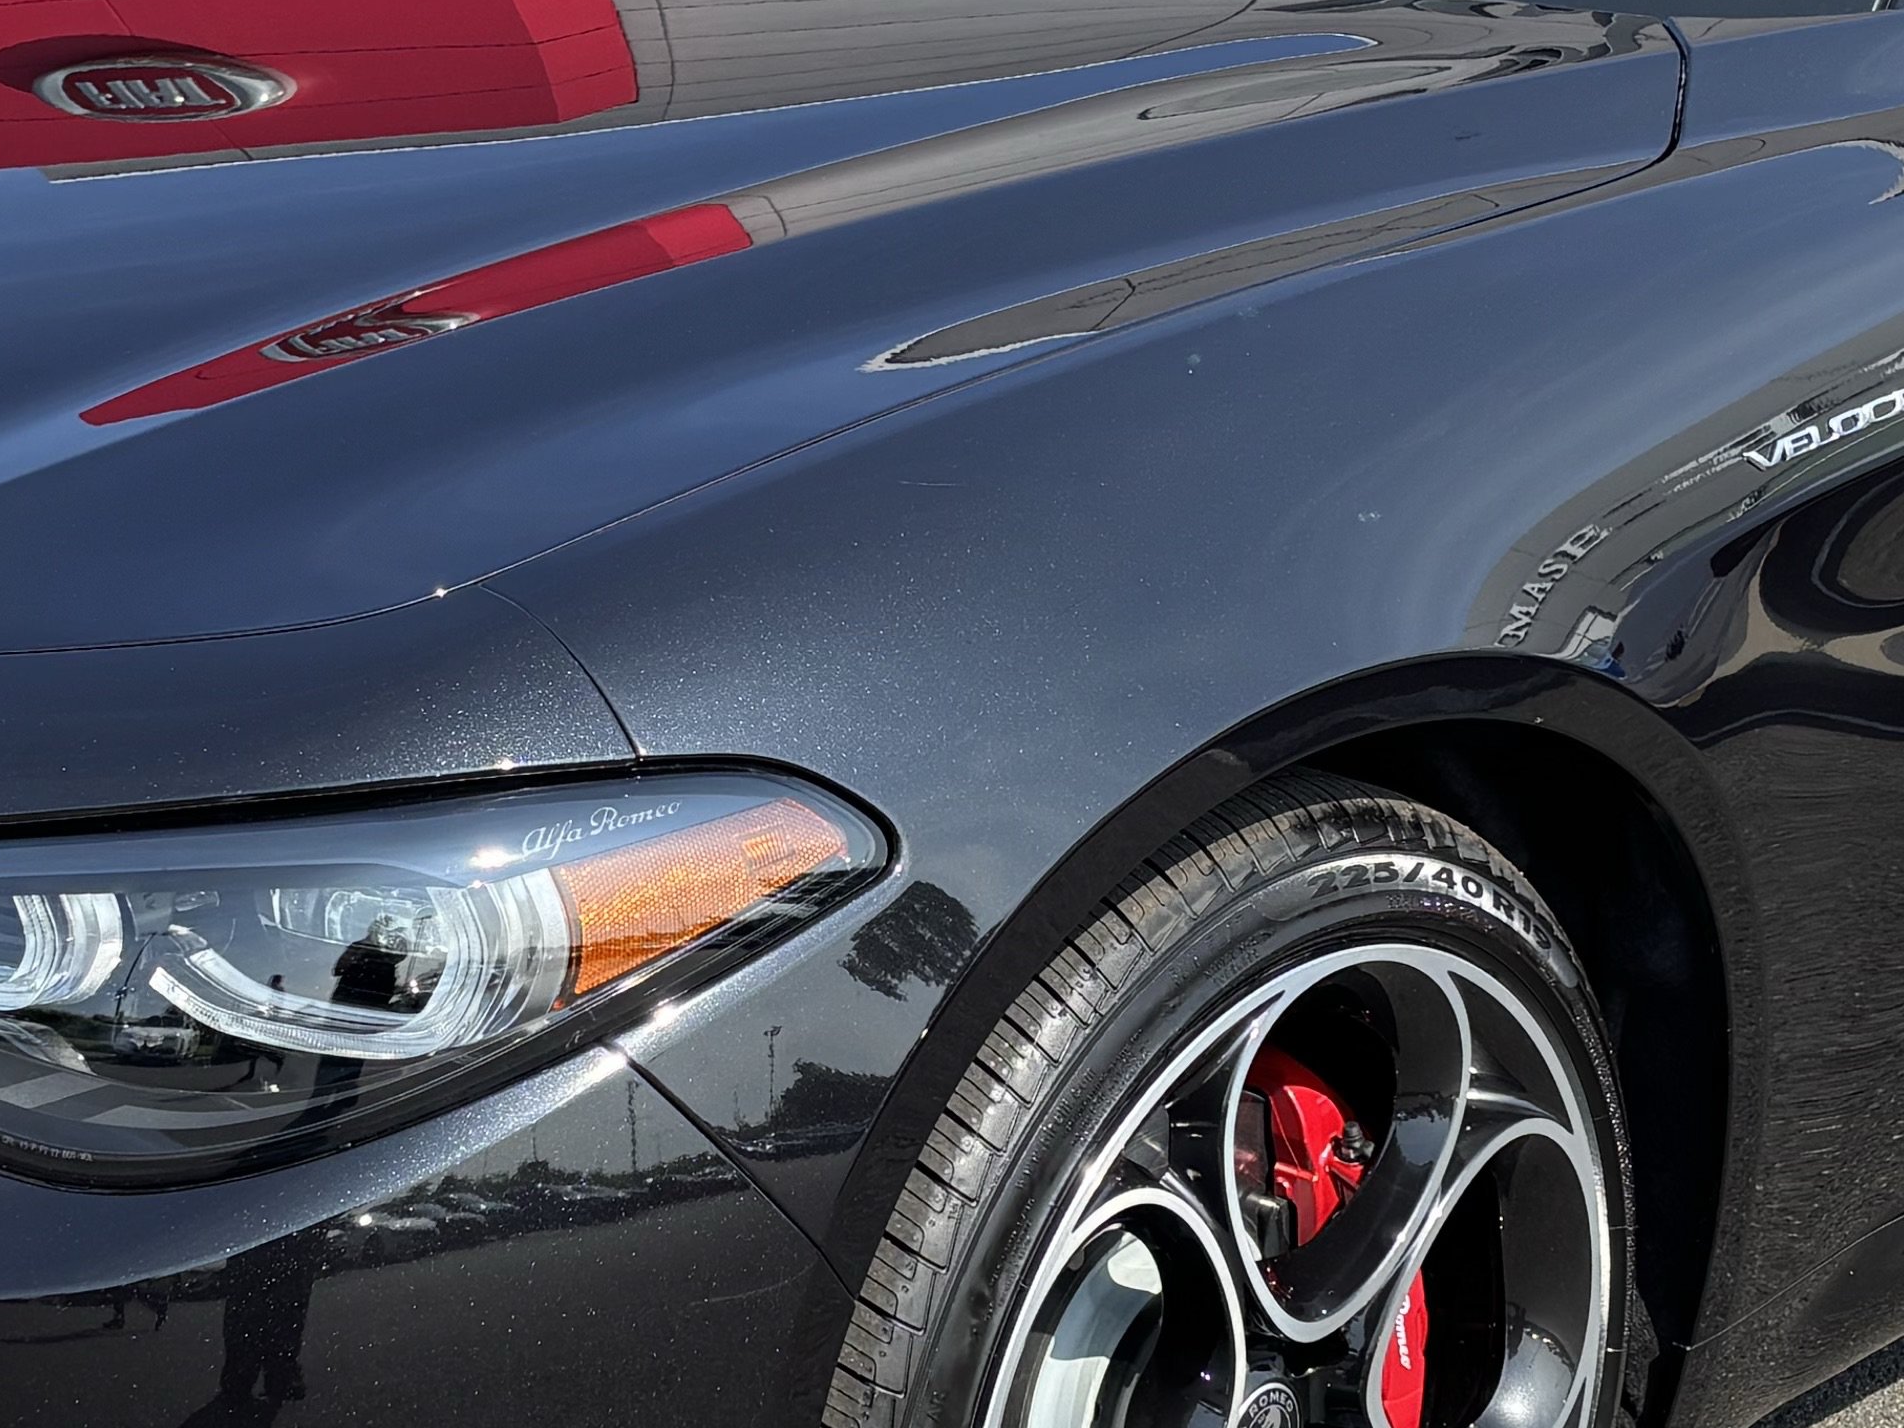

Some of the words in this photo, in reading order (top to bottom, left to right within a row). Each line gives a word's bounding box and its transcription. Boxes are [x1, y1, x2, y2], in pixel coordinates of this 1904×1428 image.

[522, 819, 587, 861] Alfa
[590, 806, 683, 836] Romeo
[1249, 1391, 1294, 1418] ROMEO
